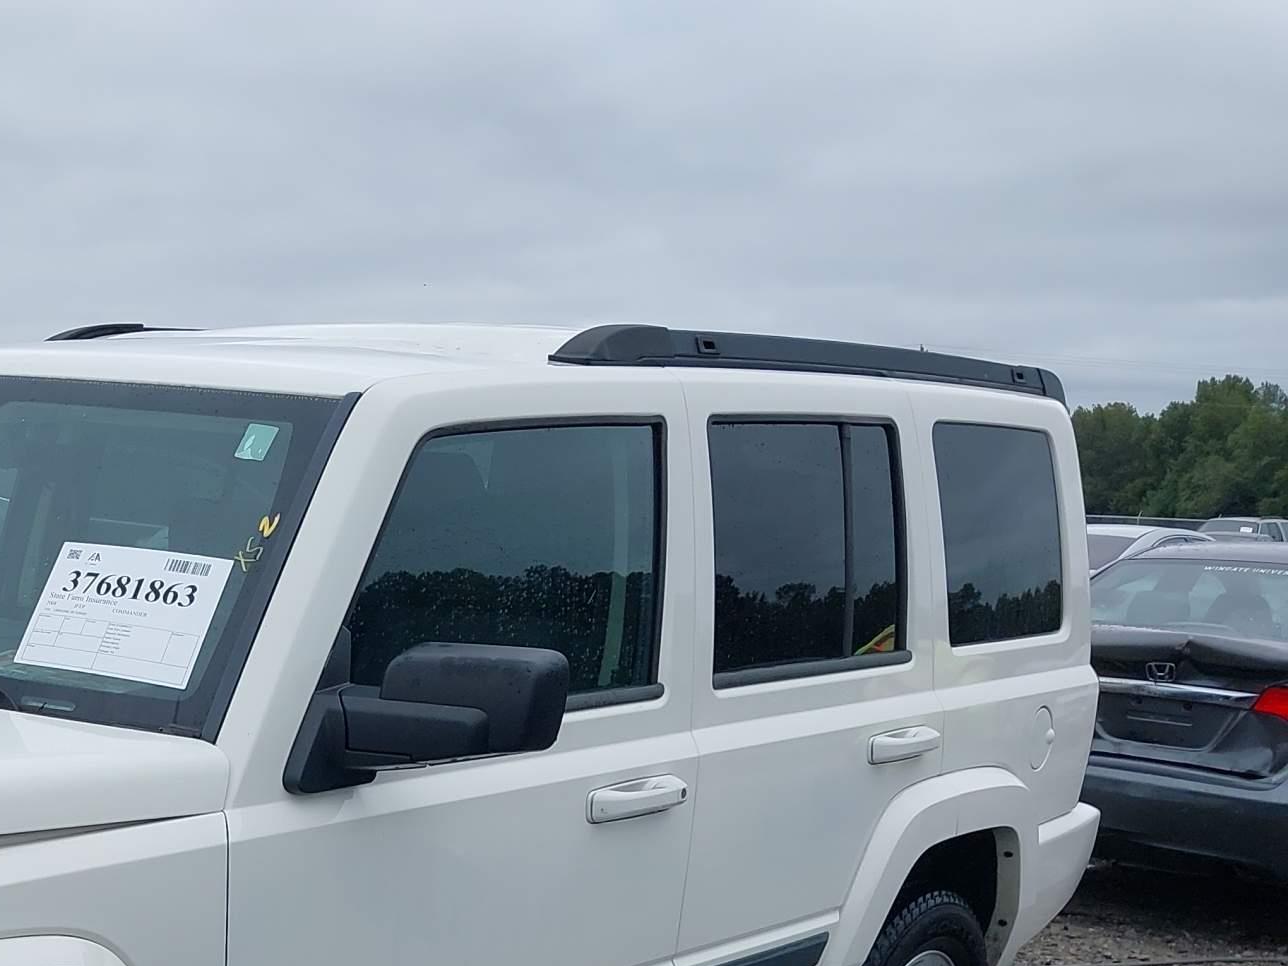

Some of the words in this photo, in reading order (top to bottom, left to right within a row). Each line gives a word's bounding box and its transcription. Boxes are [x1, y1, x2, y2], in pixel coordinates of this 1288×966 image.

[49, 592, 66, 600] State
[85, 594, 119, 607] Insurance
[61, 569, 199, 608] 37681863
